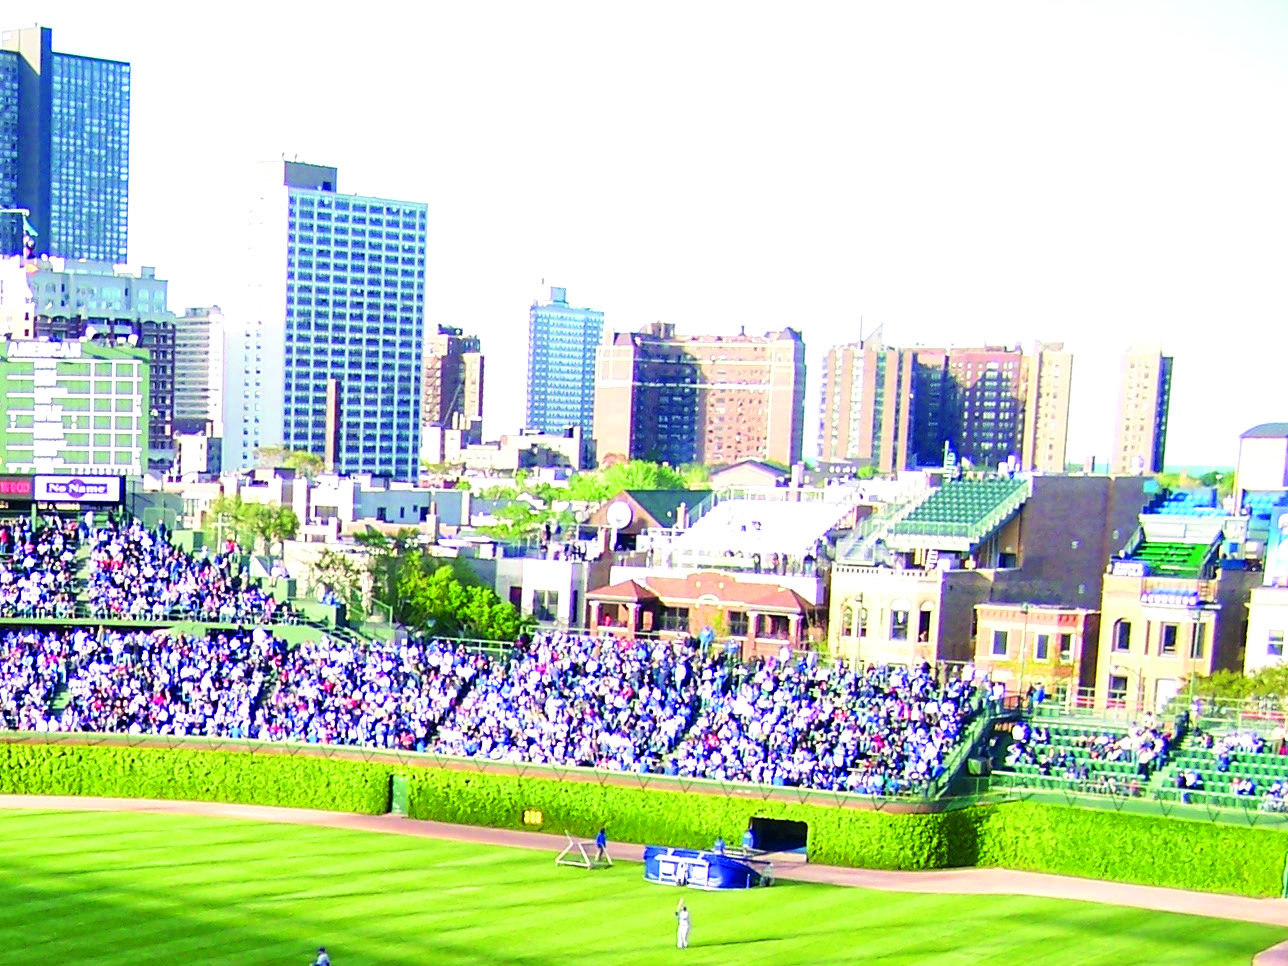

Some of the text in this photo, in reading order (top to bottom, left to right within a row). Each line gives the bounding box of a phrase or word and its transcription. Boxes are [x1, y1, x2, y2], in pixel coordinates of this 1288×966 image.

[7, 341, 81, 357] AMERICAN
[0, 481, 31, 494] WOOD
[48, 483, 106, 493] No Name
